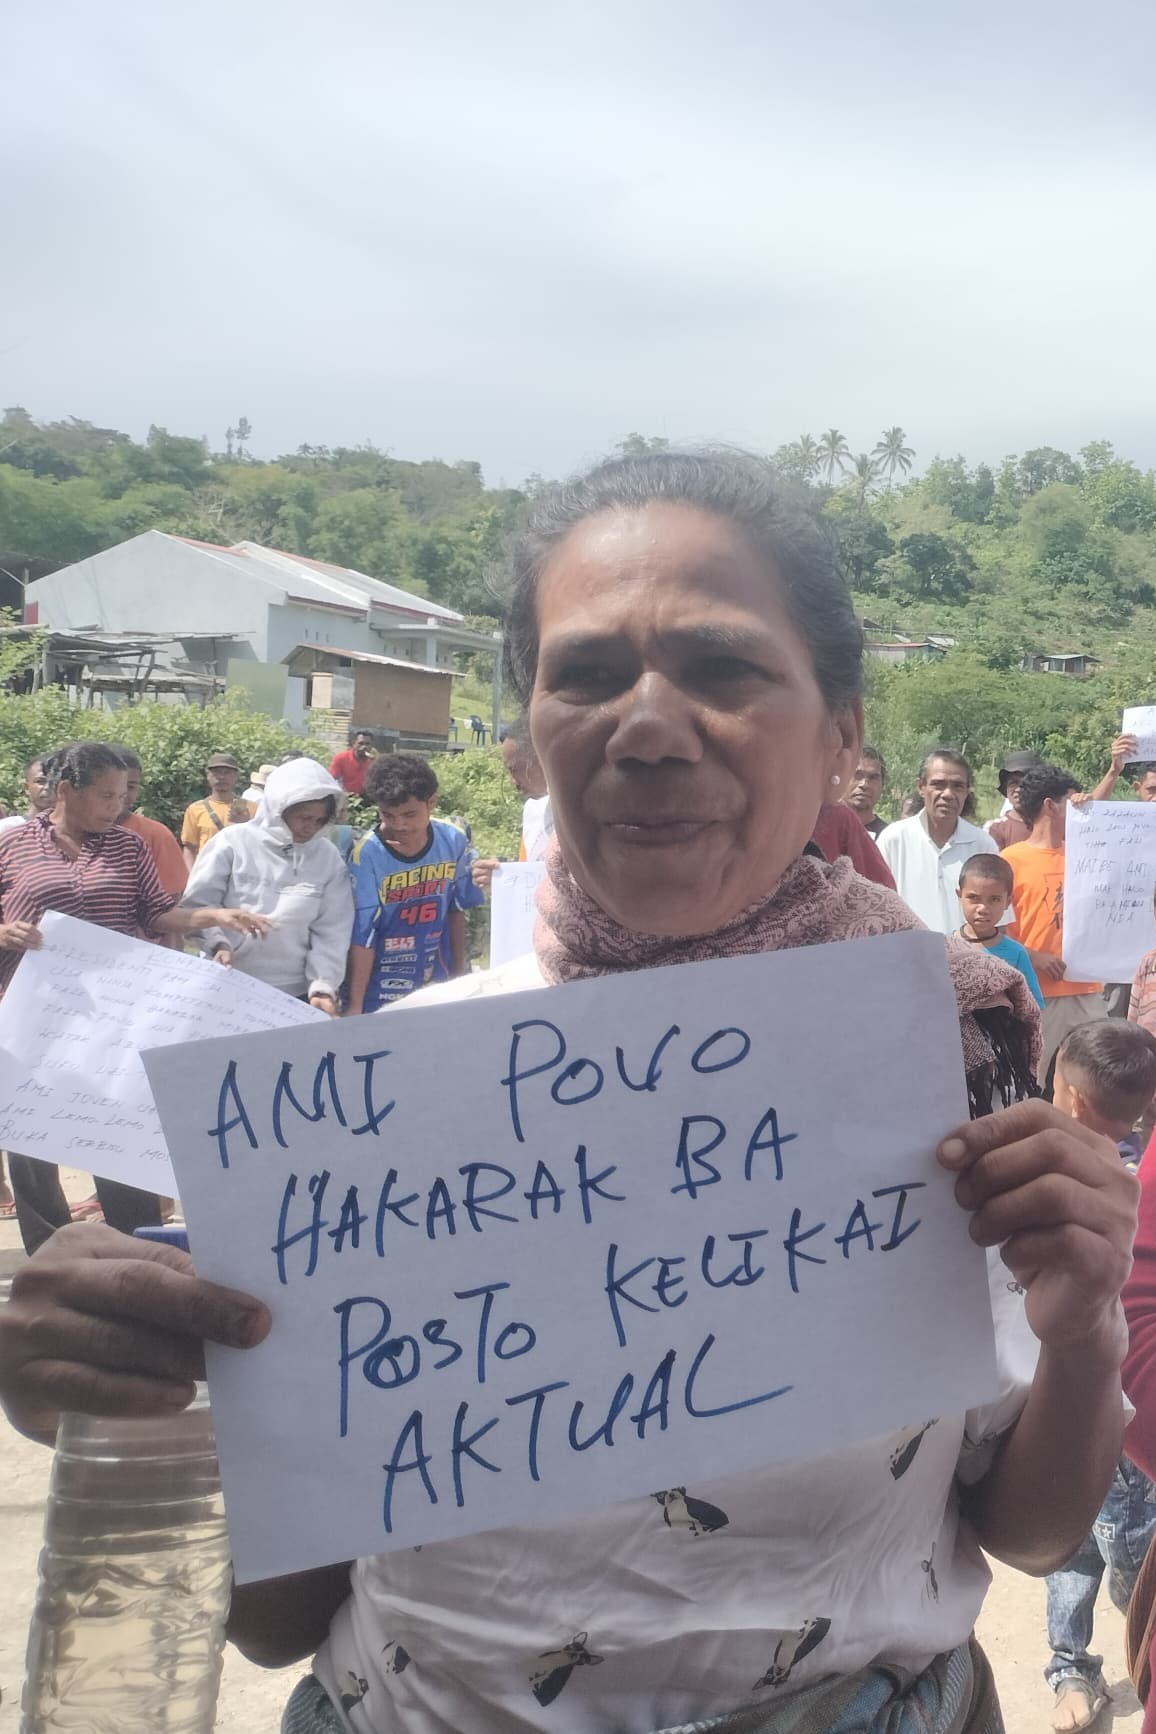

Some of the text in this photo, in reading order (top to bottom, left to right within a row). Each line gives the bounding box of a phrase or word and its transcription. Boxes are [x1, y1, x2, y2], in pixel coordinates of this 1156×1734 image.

[400, 903, 437, 925] 46
[208, 1019, 750, 1168] AMI POVO
[271, 1108, 799, 1285] HAKARAK BA
[336, 1182, 927, 1437] POSTO KELIKAI
[383, 1334, 794, 1533] AKTUAL
